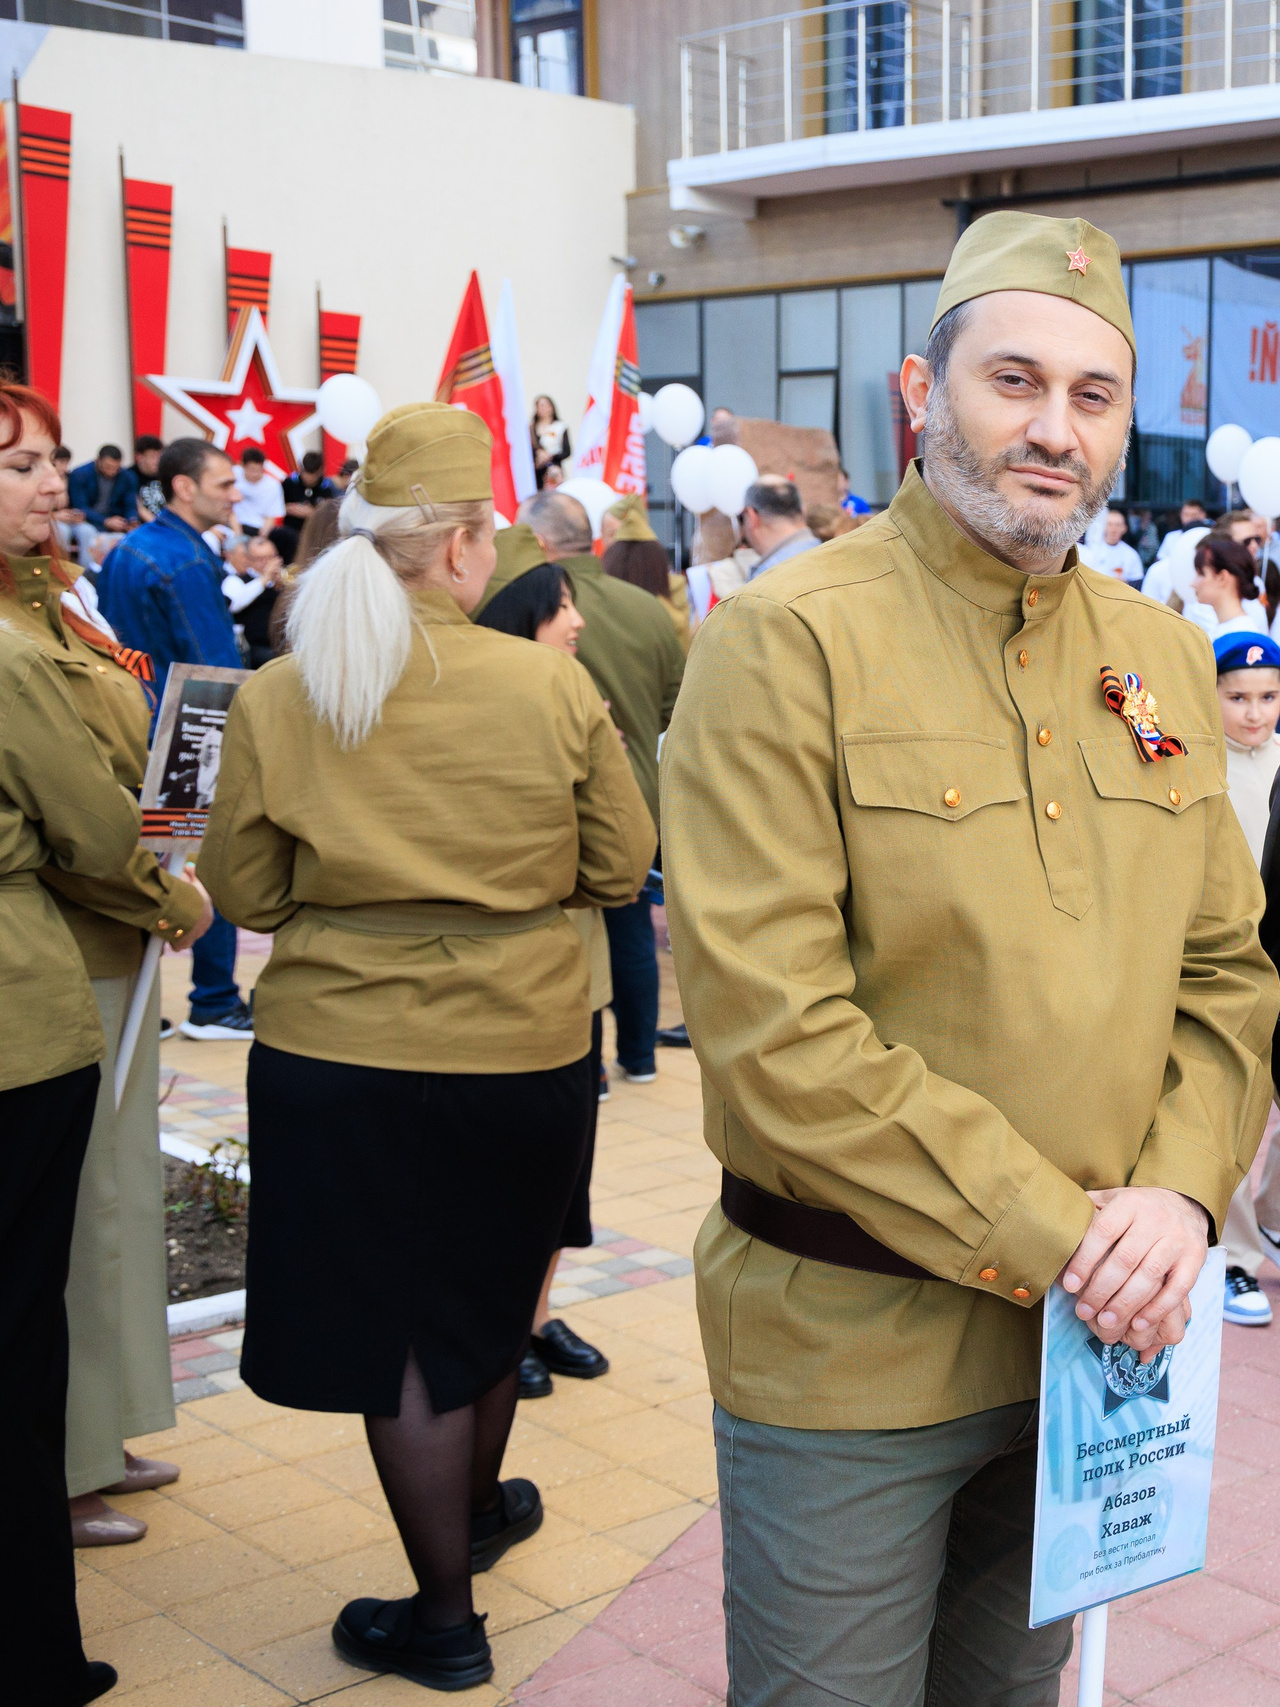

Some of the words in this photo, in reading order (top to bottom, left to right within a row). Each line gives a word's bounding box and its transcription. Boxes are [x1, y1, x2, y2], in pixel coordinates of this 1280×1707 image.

[1076, 1413, 1191, 1460] Бессмертный
[1082, 1459, 1125, 1482] полк
[1128, 1441, 1186, 1469] России
[1102, 1486, 1156, 1512] Абазов
[1101, 1512, 1153, 1539] Хаваж
[1093, 1549, 1107, 1560] Без
[1108, 1541, 1129, 1555] вести
[1130, 1533, 1156, 1548] пропал
[1080, 1570, 1094, 1580] при
[1095, 1562, 1112, 1575] боях
[1113, 1560, 1122, 1569] за
[1123, 1545, 1167, 1566] Прибалтику
